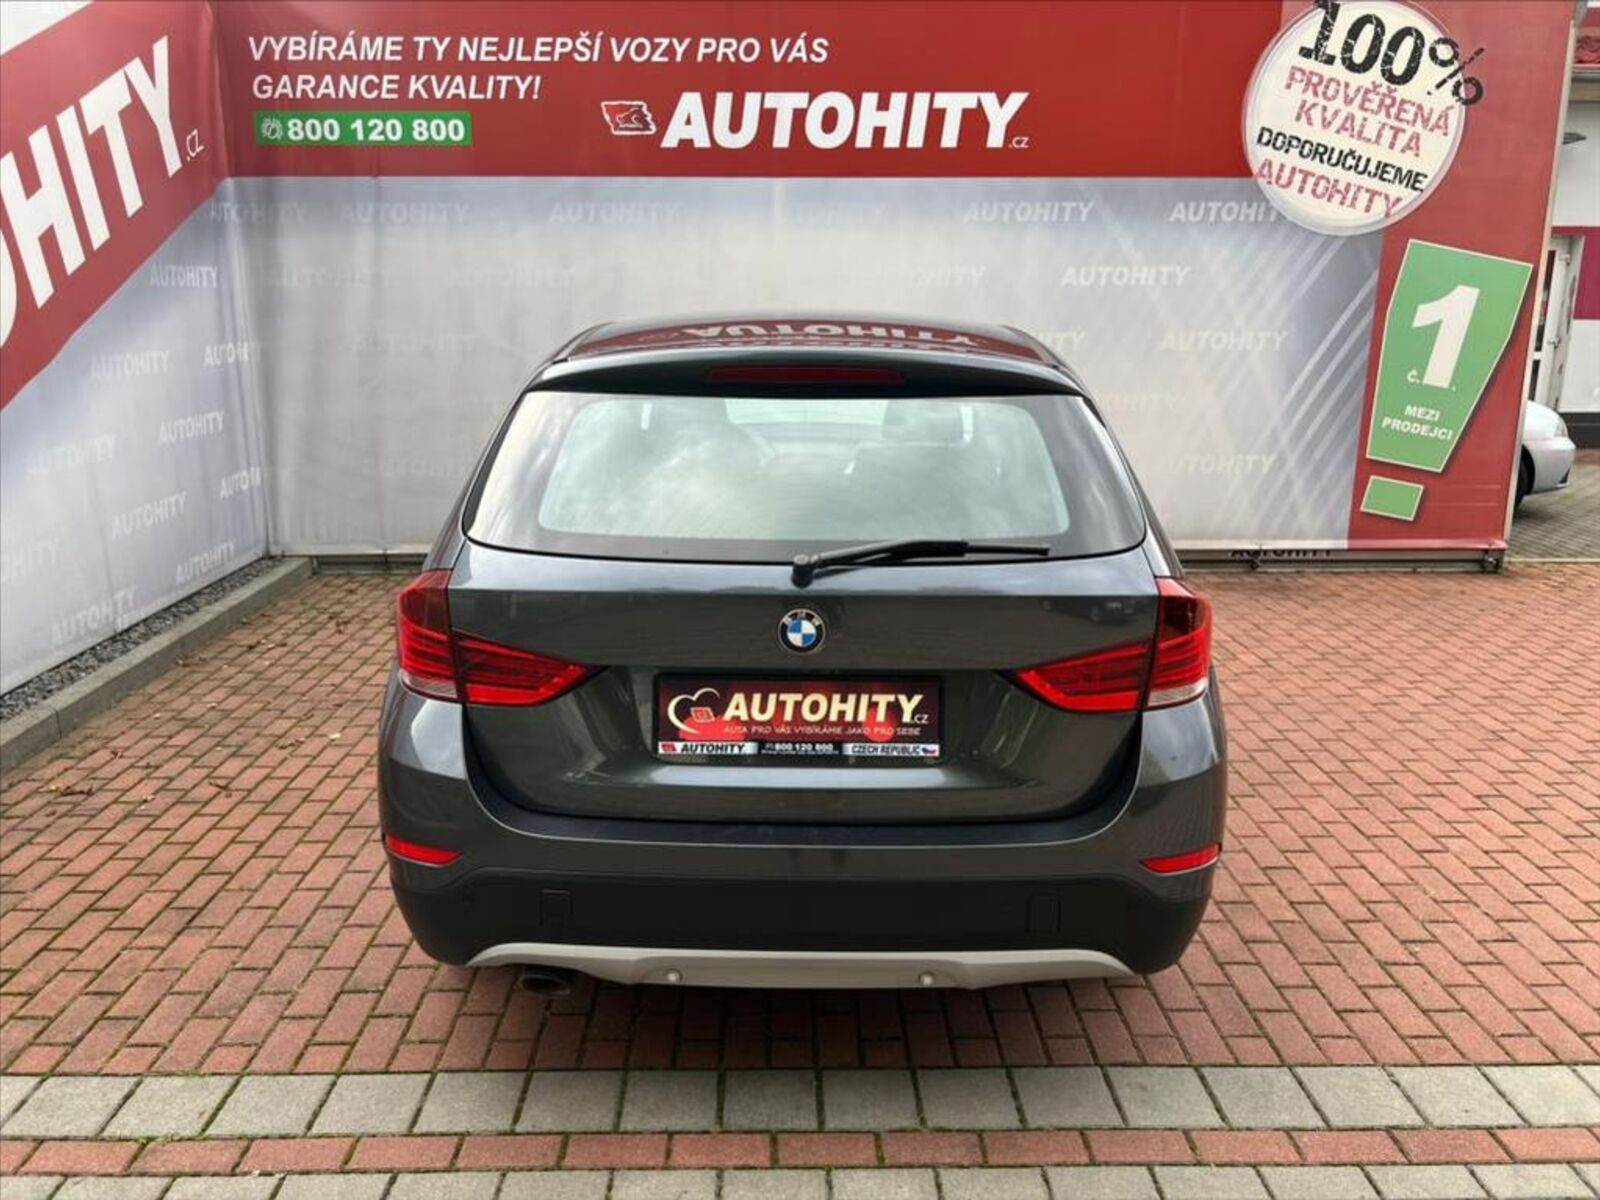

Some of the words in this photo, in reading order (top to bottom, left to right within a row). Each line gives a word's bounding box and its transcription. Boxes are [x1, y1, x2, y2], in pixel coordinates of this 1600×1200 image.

[249, 30, 403, 61] VYBÍRÁME
[413, 36, 450, 61] TY
[458, 31, 603, 62] NEJLEPŠÍ
[610, 37, 692, 62] VOZY
[697, 37, 761, 62] PRO
[770, 32, 829, 62] VÁS
[1299, 0, 1485, 106] 100%
[253, 74, 399, 99] GARANCE
[408, 74, 541, 100] KVALITY!
[1285, 66, 1454, 136] PROVĚŘENÁ
[287, 118, 340, 141] 800
[351, 118, 402, 141] 120
[412, 118, 465, 141] 800
[1295, 100, 1421, 157] KVALITA
[1256, 126, 1428, 192] DOPORUČUJEME
[1256, 159, 1404, 218] AUTOHITY
[964, 201, 1095, 224] AUTOHITY
[1169, 201, 1280, 223] AUTOHIT
[150, 264, 218, 288] AUTOHITY
[1060, 266, 1192, 287] AUTOHITY
[1159, 331, 1289, 352] AUTOHITY
[1404, 405, 1440, 422] MEZI
[159, 411, 225, 446] AUTOHITY
[1381, 417, 1453, 441] PRODEJCI
[111, 491, 187, 542] AUTOHITY
[175, 541, 236, 585] AUTOHITY
[681, 743, 745, 753] AUTOHITY
